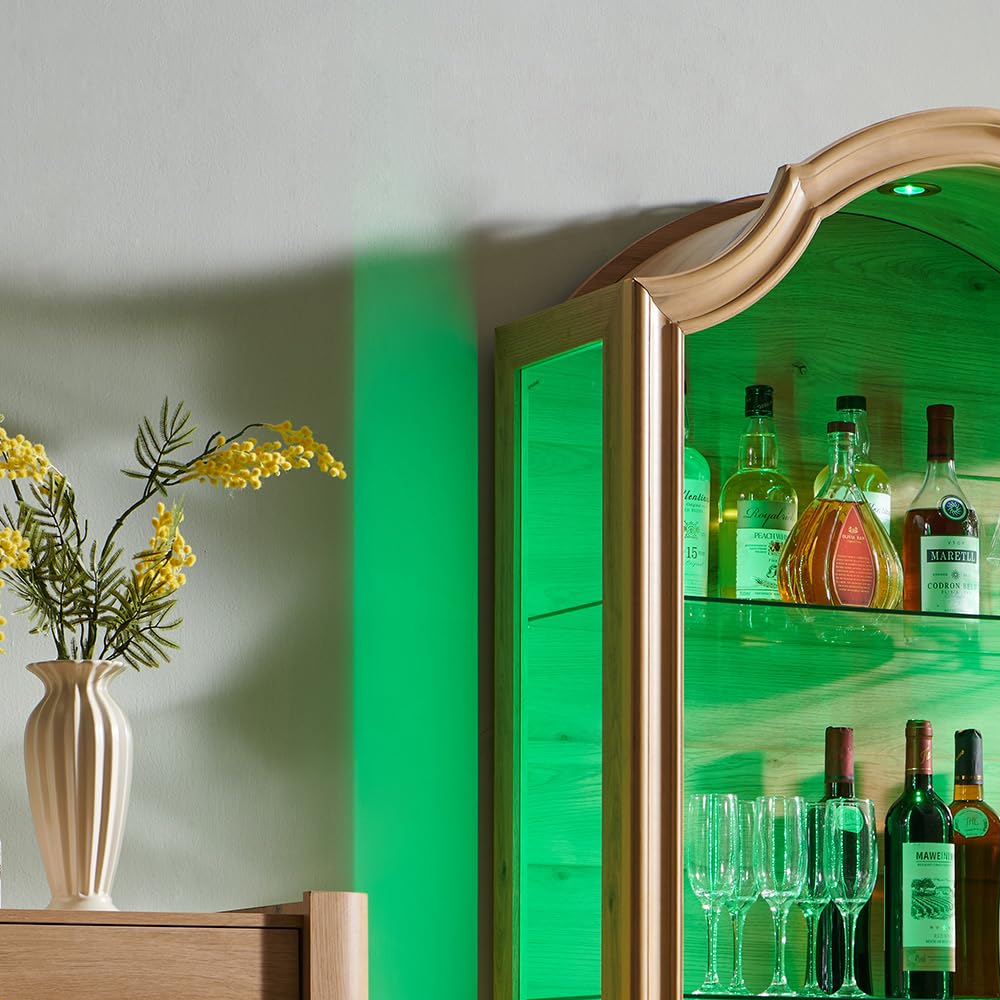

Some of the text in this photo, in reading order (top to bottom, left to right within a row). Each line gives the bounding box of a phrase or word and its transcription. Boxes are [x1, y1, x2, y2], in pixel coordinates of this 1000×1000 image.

[687, 546, 697, 559] 15
[931, 551, 976, 562] MARETLL
[928, 582, 960, 590] CODRON
